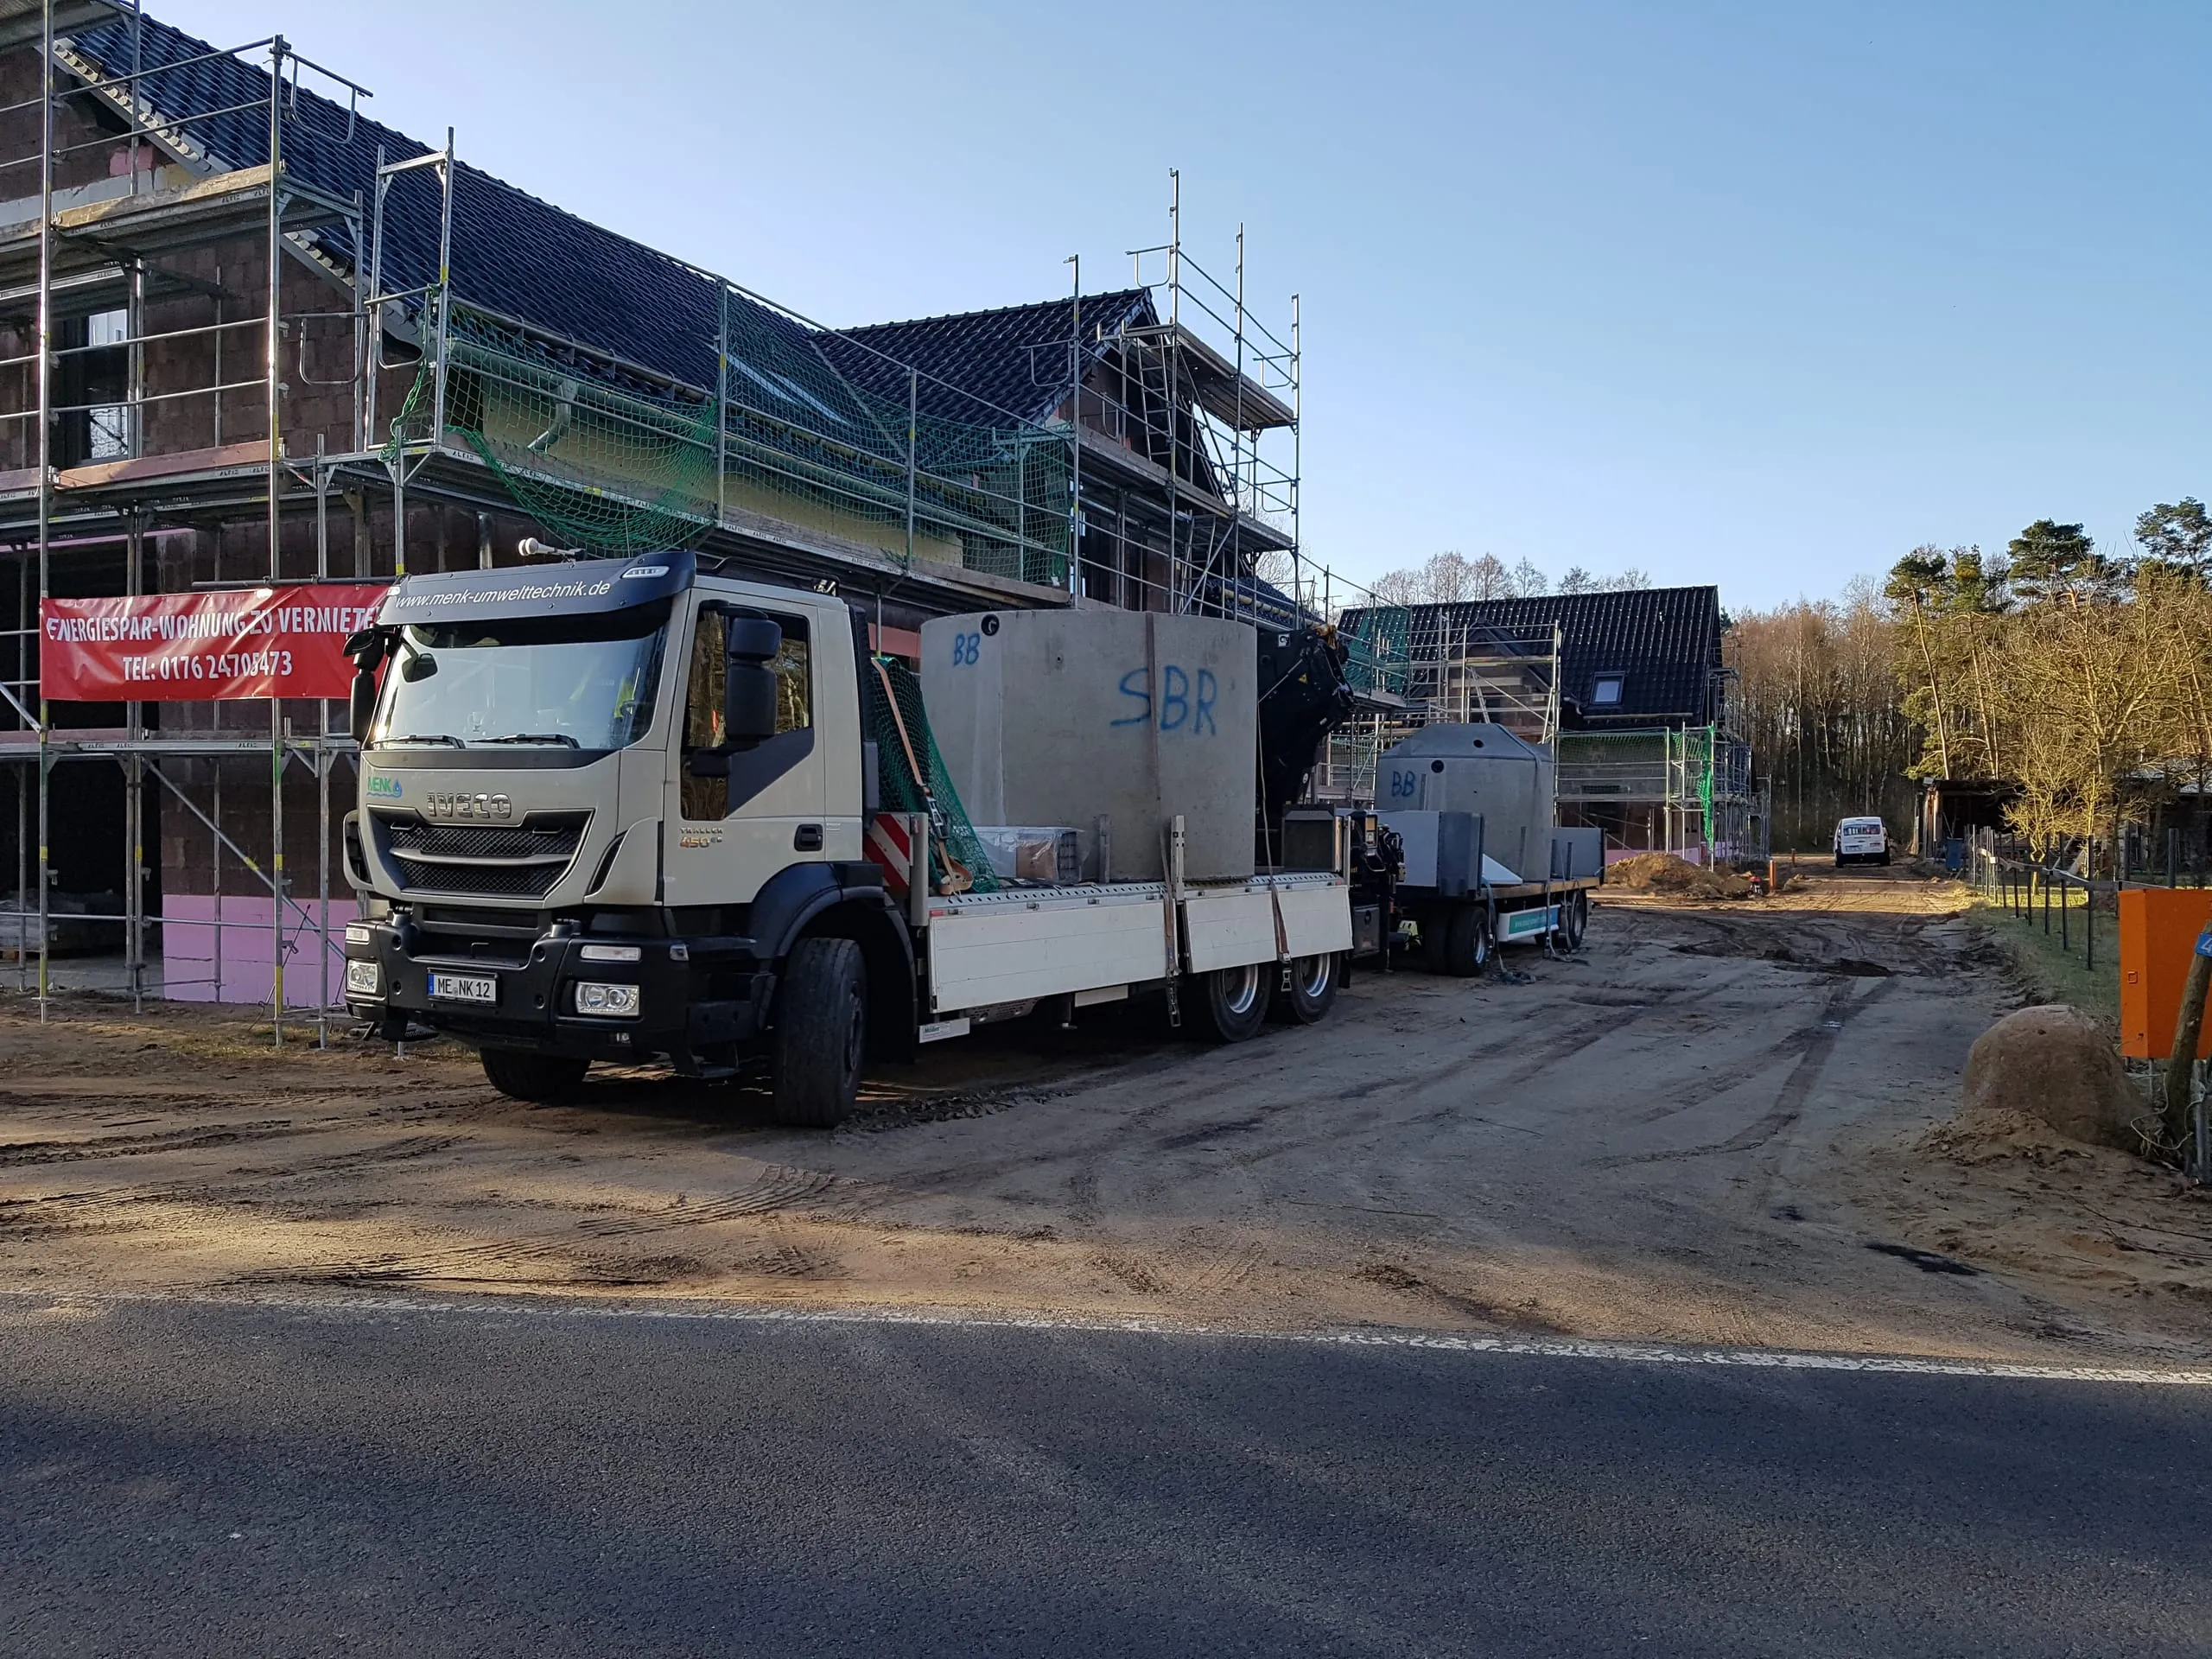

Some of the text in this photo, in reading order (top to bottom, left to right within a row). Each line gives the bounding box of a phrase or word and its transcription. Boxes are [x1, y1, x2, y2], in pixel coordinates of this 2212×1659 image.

[395, 580, 612, 608] www.menk-umwelttechnik.de
[46, 611, 246, 642] ENERGIESPAR-WOHNUNG
[277, 607, 380, 632] VERMIETE
[953, 632, 981, 667] BB
[123, 651, 292, 681] TEL: 0176 24705473
[1109, 664, 1217, 736] SBR
[1391, 770, 1416, 797] BB
[427, 792, 512, 818] IVECO
[437, 978, 491, 998] ME NK 12
